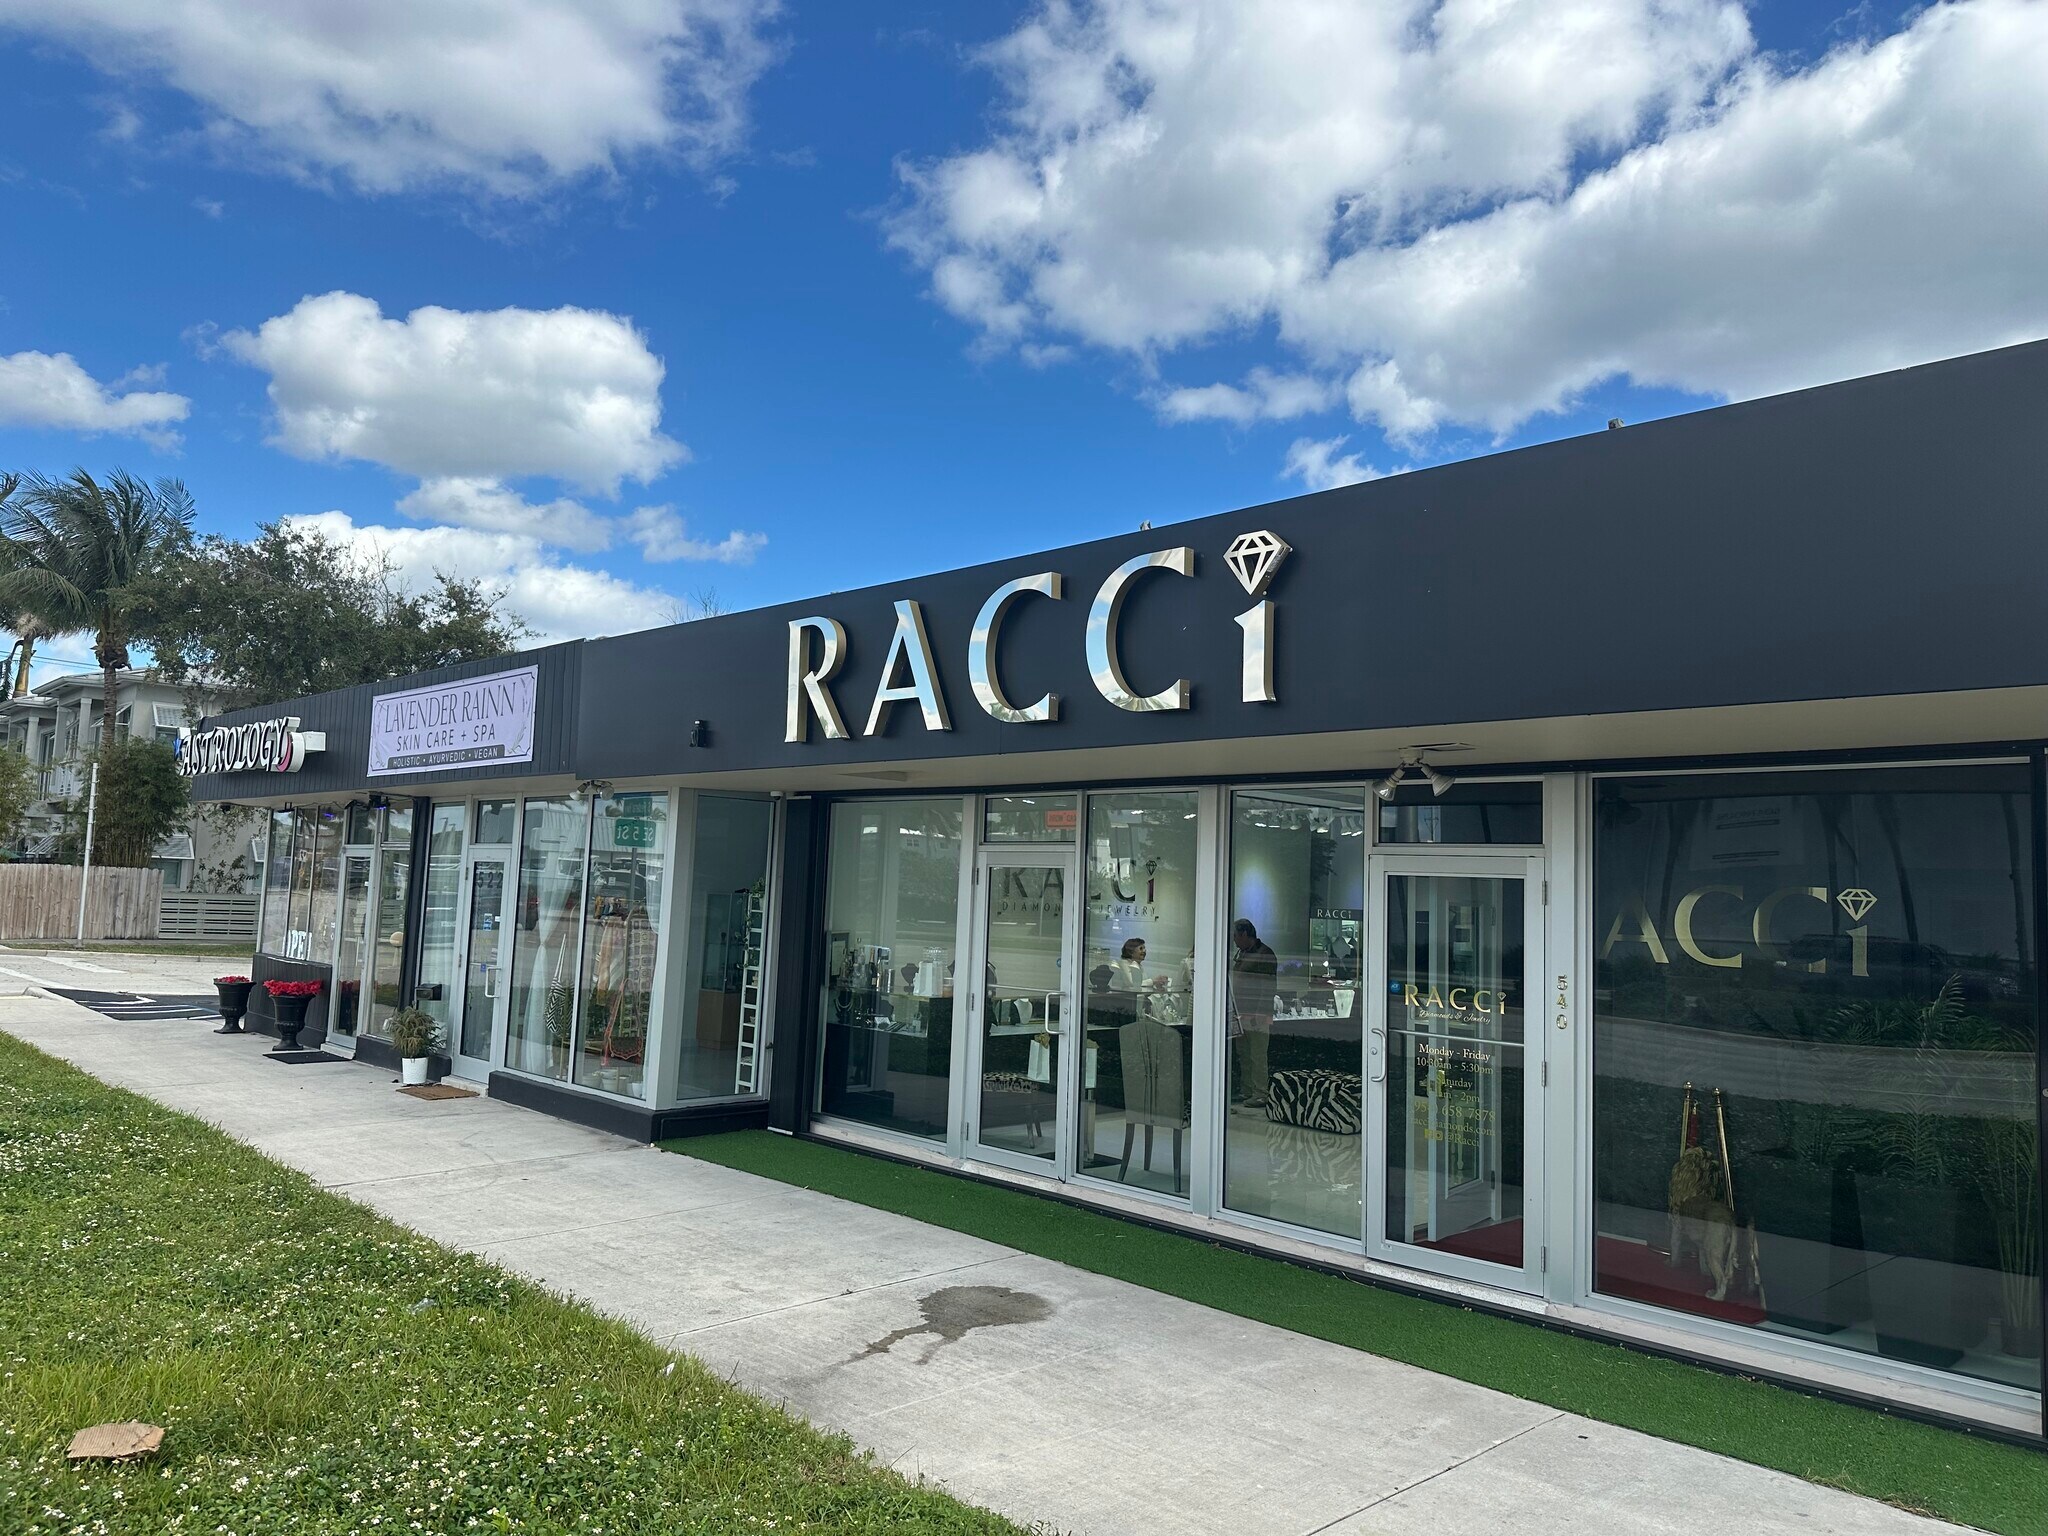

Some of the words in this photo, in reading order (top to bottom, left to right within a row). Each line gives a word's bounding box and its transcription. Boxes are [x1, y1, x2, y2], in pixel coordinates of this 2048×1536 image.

[385, 693, 457, 733] LAVENDER
[461, 682, 516, 722] RAINN
[180, 717, 291, 775] ASTROLOGY
[397, 733, 421, 751] SKIN
[426, 729, 454, 748] CARE
[461, 730, 467, 742] +
[473, 723, 496, 743] SPA
[393, 756, 421, 767] HOLISTIC
[428, 750, 466, 764] AYURVEDIC
[474, 747, 498, 759] VEGAN
[1556, 975, 1568, 1030] 540
[1419, 1043, 1454, 1059] Monday
[1463, 1048, 1491, 1063] Friday
[1416, 1056, 1452, 1070] 10:30am
[1461, 1062, 1494, 1075] 5:30pm
[1461, 1091, 1480, 1103] 2pm
[1441, 1105, 1462, 1118] 658
[1468, 1107, 1496, 1122] 7878
